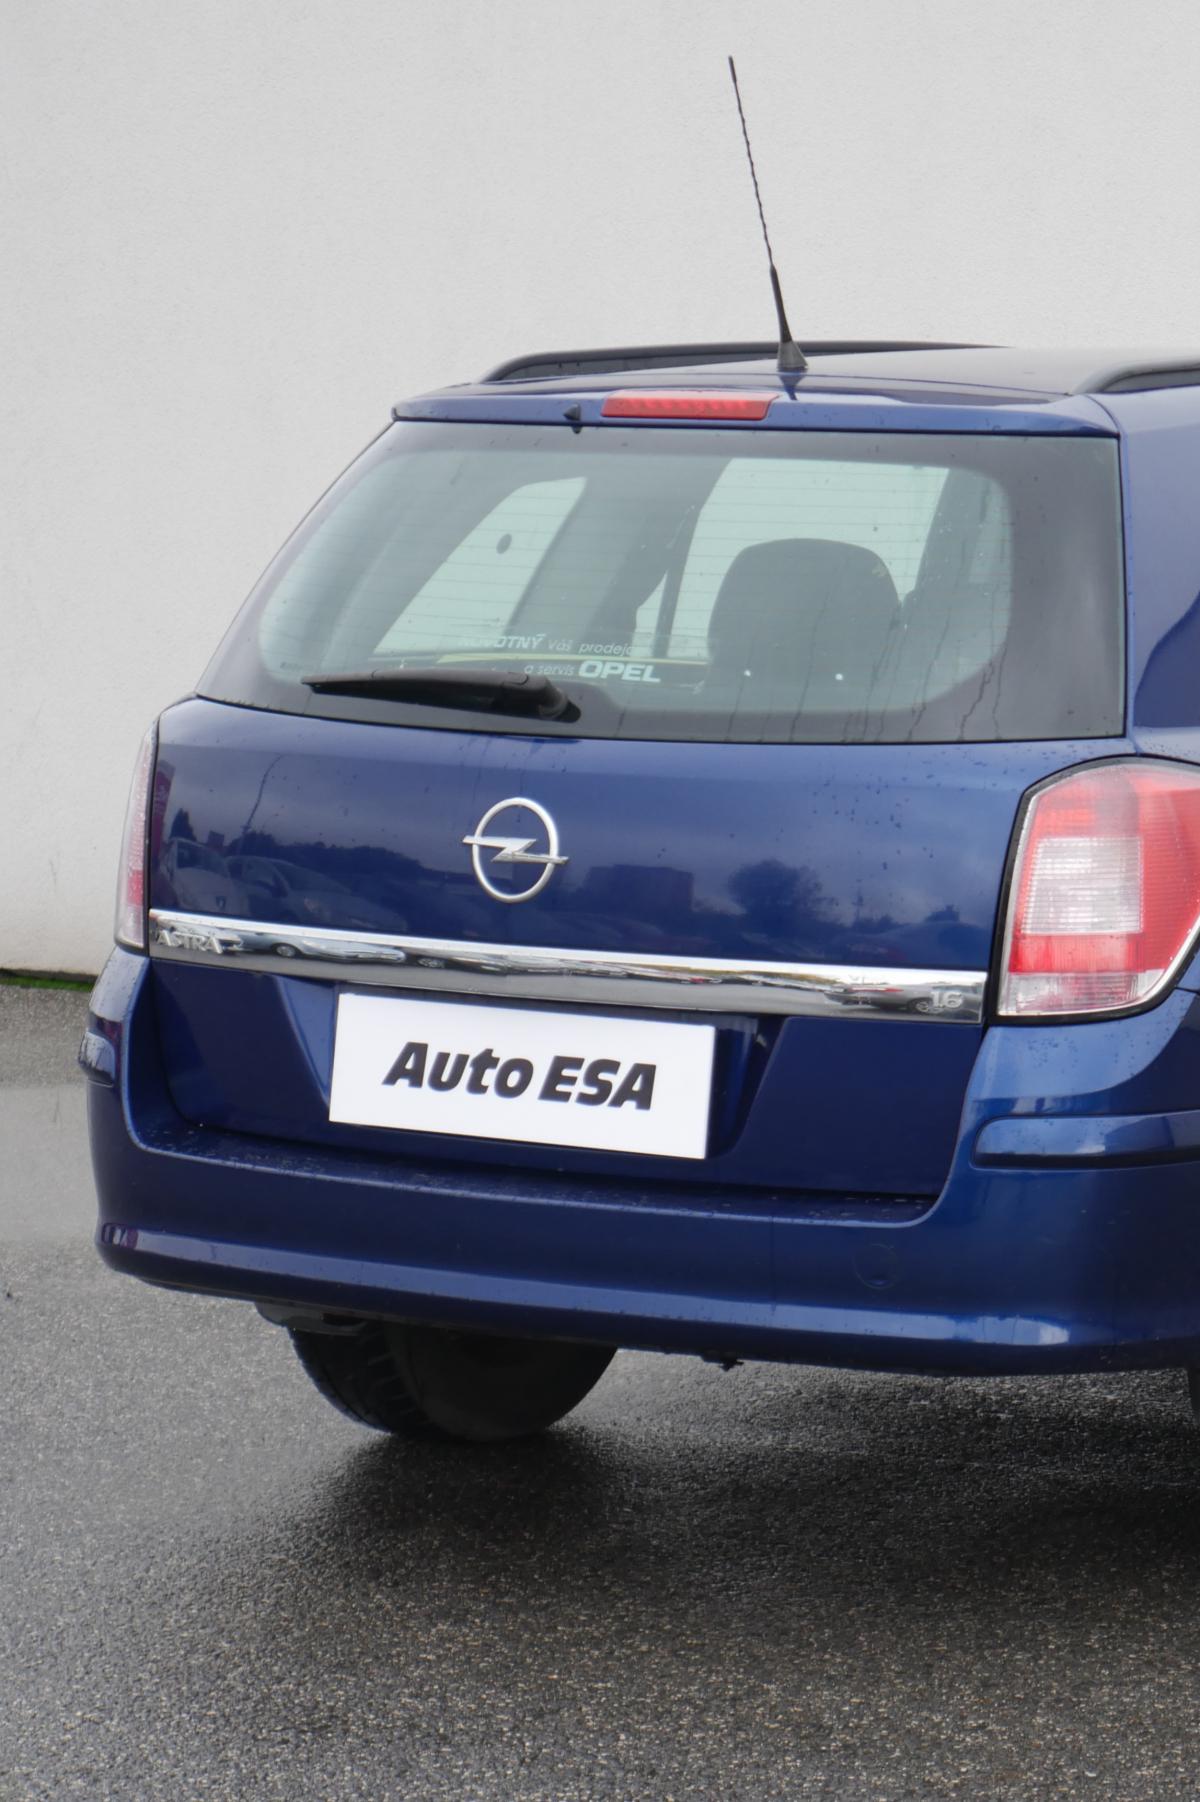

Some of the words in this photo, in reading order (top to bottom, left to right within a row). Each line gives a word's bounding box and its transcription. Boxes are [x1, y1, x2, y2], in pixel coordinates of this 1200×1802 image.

[578, 642, 638, 656] prodejc
[536, 664, 575, 676] servis
[578, 660, 662, 683] OPEL
[156, 929, 223, 954] ASTRA
[382, 1041, 534, 1099] Auto
[538, 1055, 657, 1111] ESA
